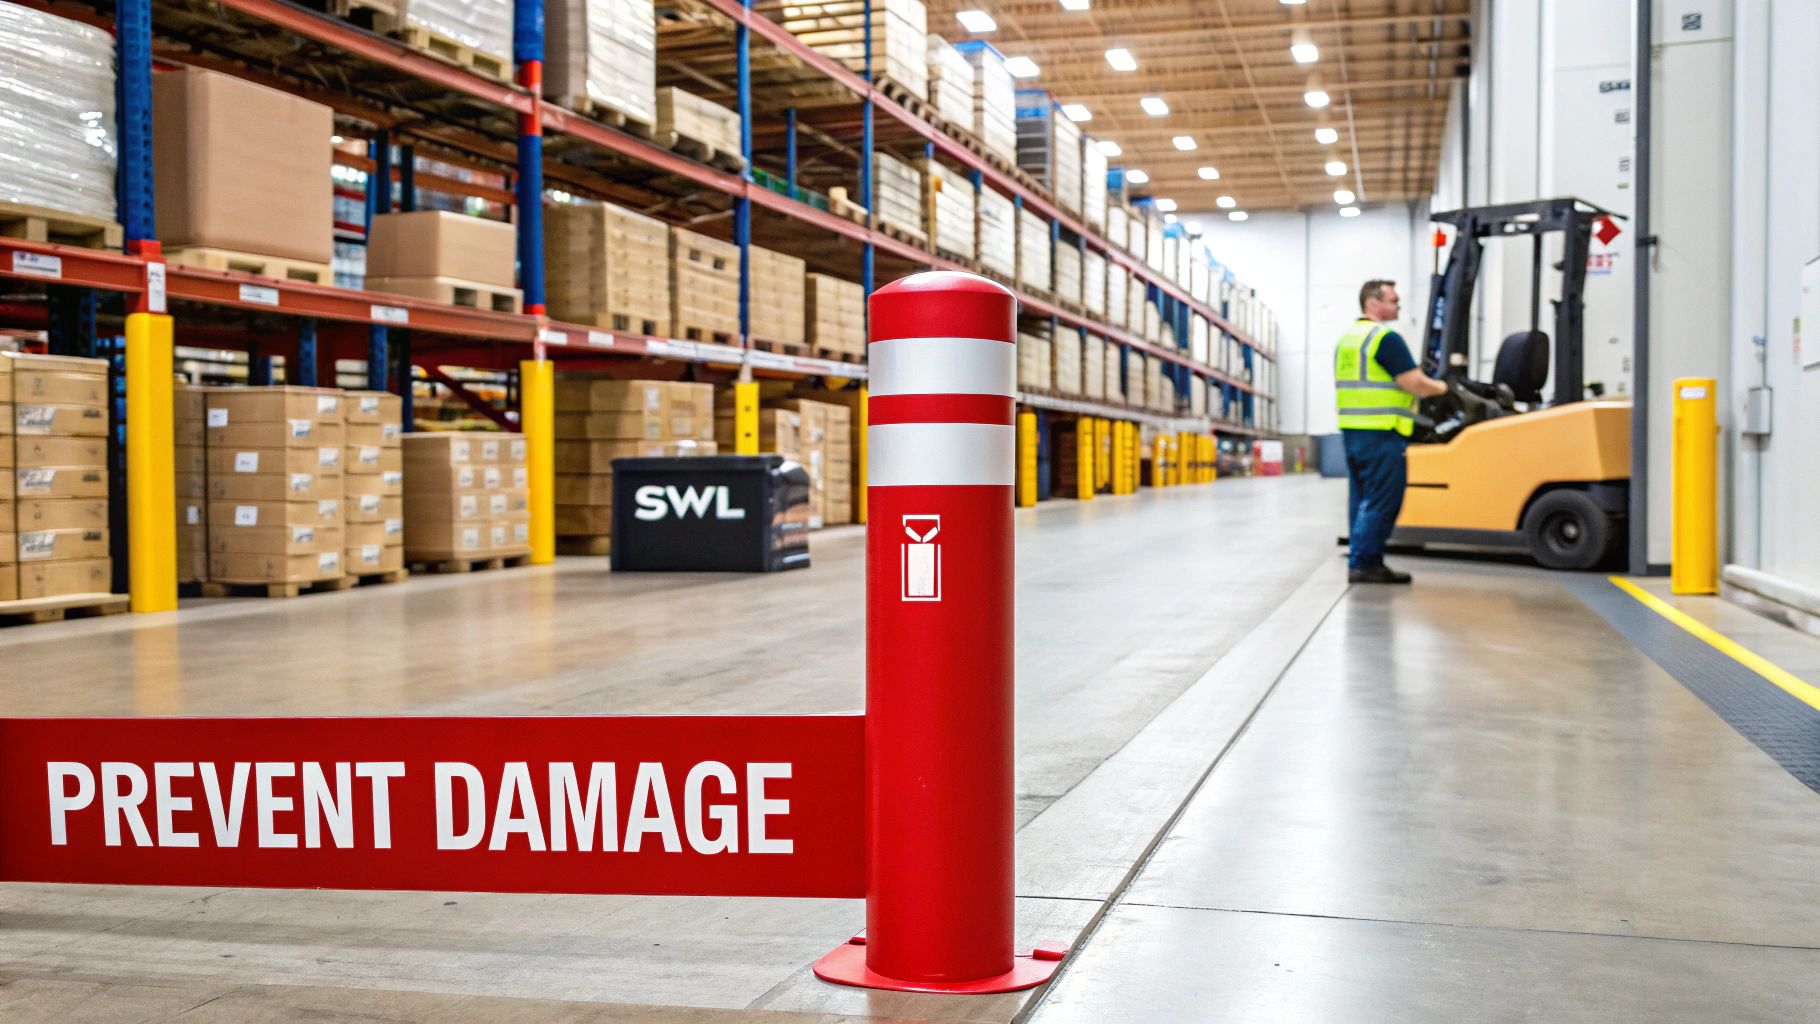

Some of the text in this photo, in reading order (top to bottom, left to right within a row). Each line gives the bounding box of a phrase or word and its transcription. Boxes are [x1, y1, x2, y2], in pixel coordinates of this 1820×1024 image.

[634, 485, 745, 520] SWL
[47, 761, 794, 855] PREVENT DAMAGE
